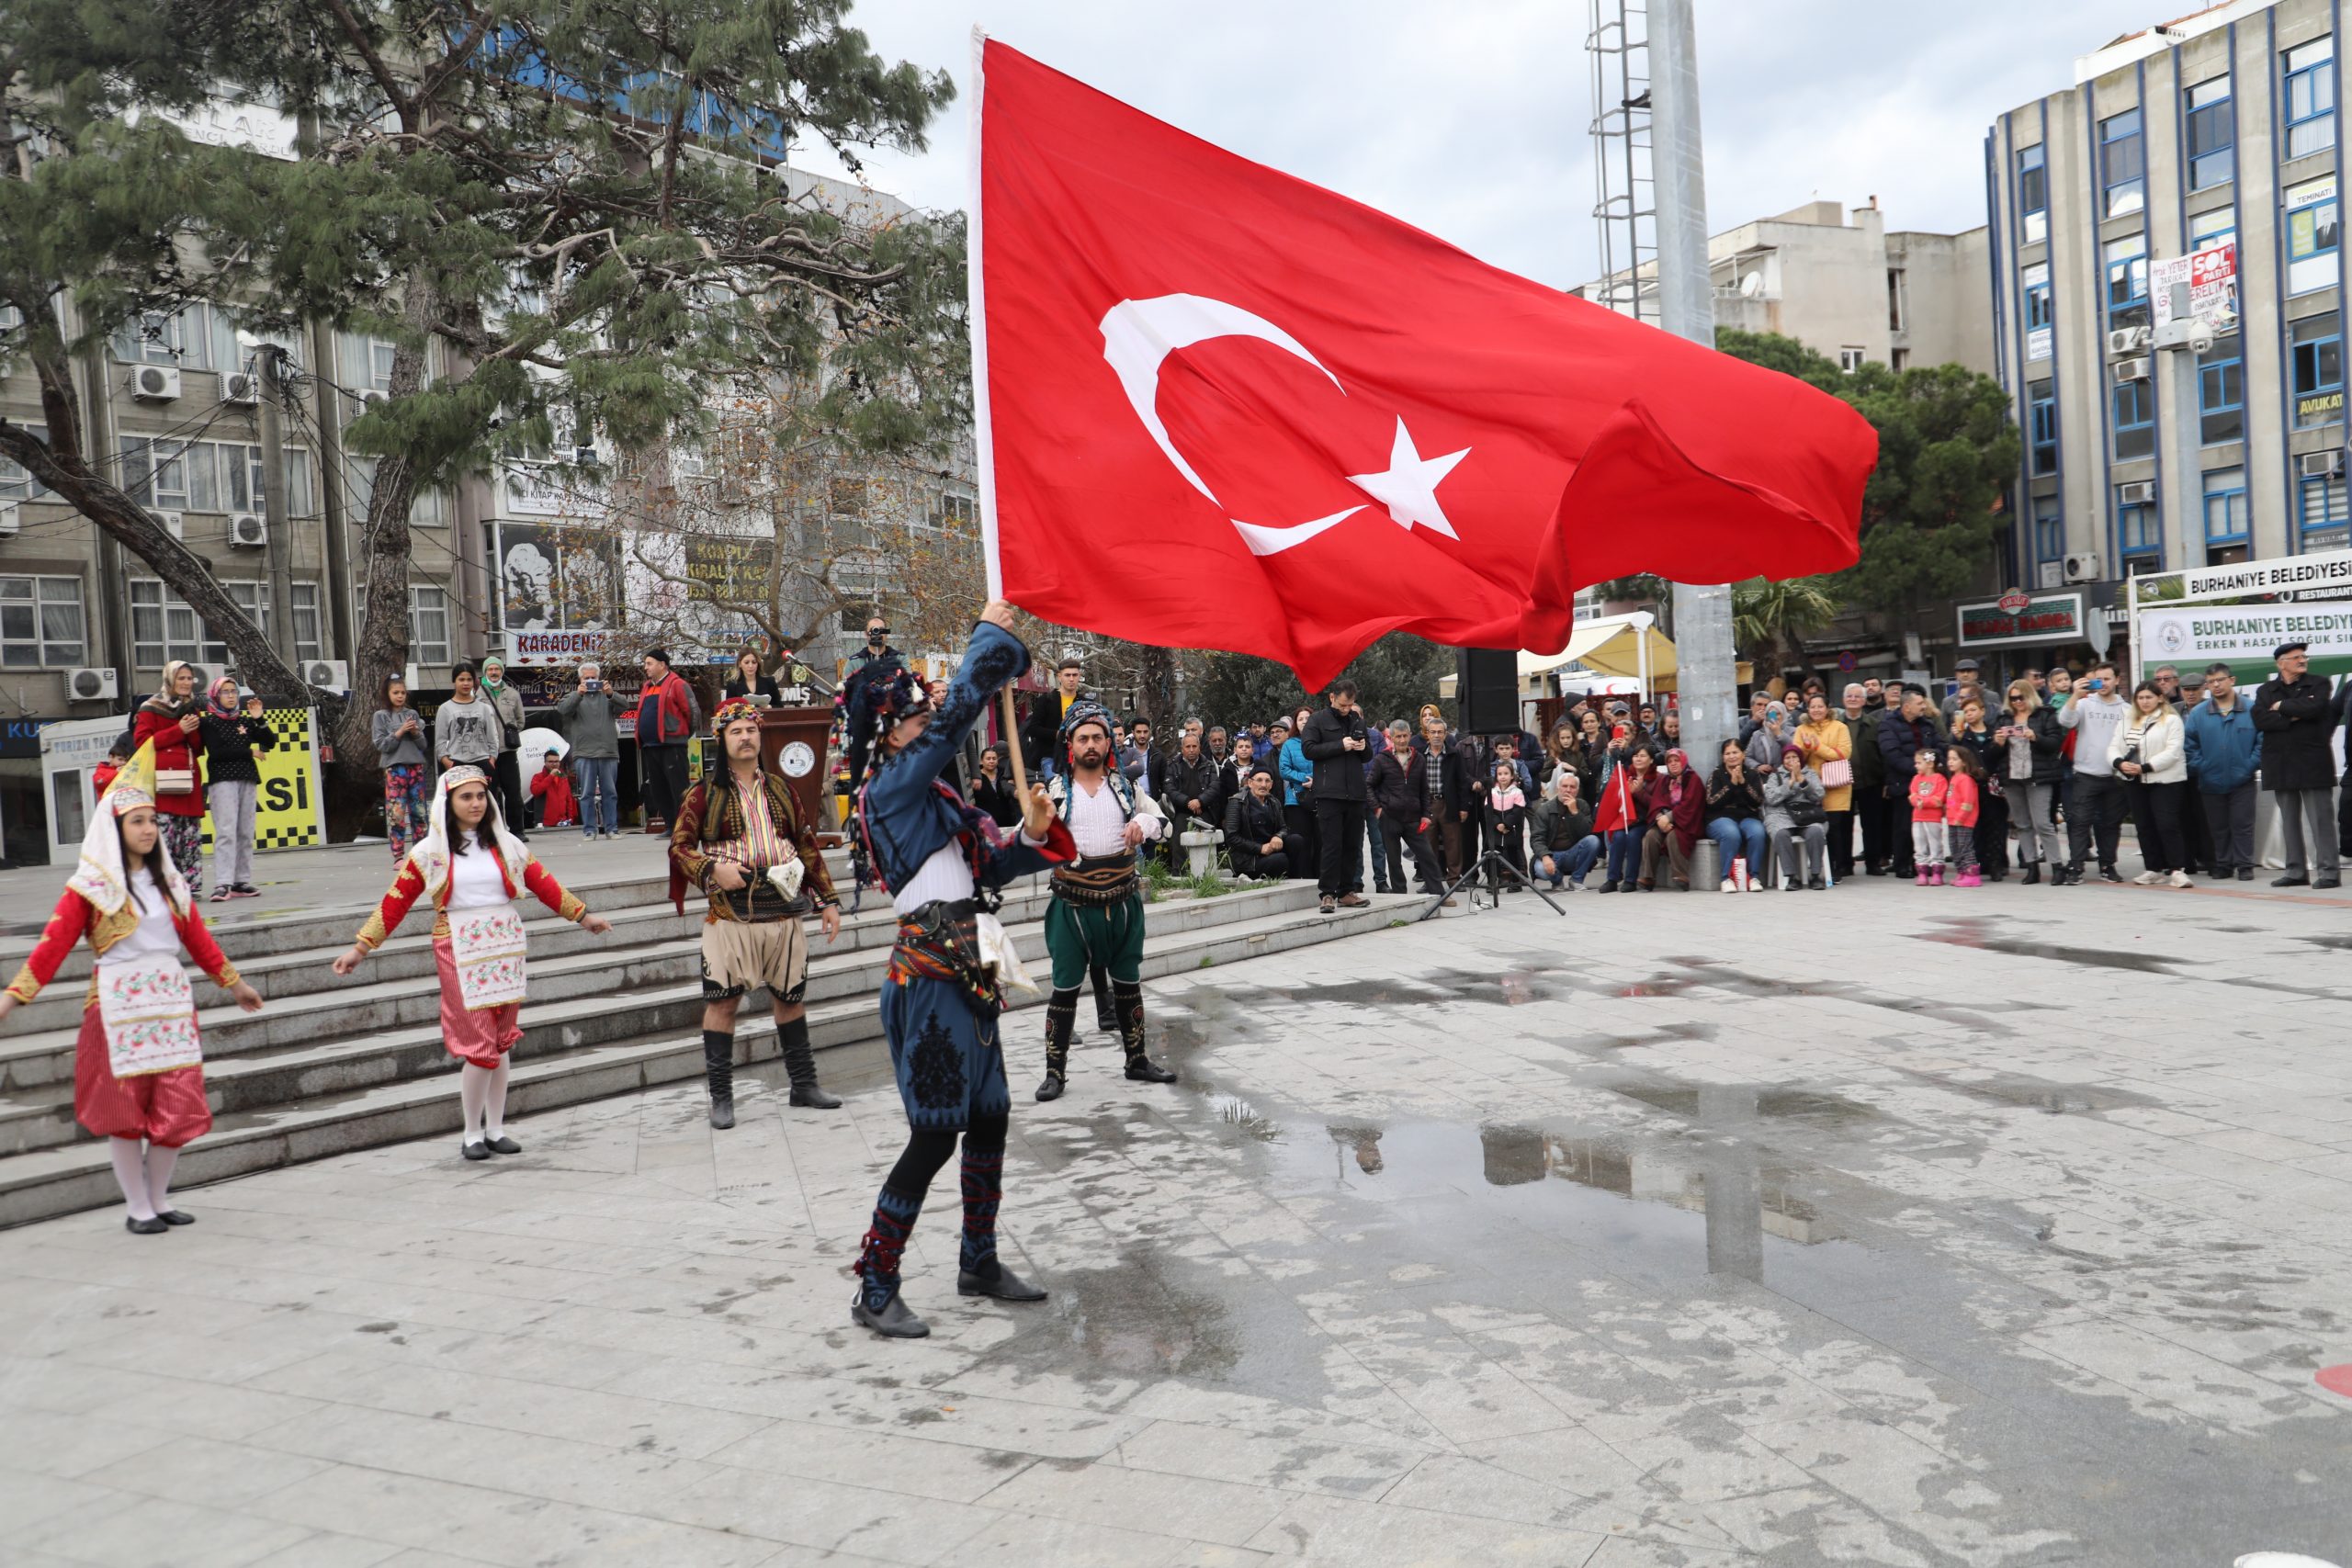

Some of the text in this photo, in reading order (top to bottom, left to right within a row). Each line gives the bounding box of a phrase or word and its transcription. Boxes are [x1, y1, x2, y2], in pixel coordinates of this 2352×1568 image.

[2193, 249, 2231, 276] SOL
[2203, 265, 2231, 281] PARTİ
[2300, 393, 2343, 415] AVUKAT
[2191, 559, 2352, 594] BURHANİYE BELEDİYESİ
[2192, 616, 2283, 637] BURHANİYE
[517, 632, 607, 654] KARADENİZ
[2197, 637, 2237, 650] ERKEN
[2243, 637, 2283, 648] HASAT
[2289, 634, 2331, 645] SOĞUK
[779, 683, 811, 705] MİŞ
